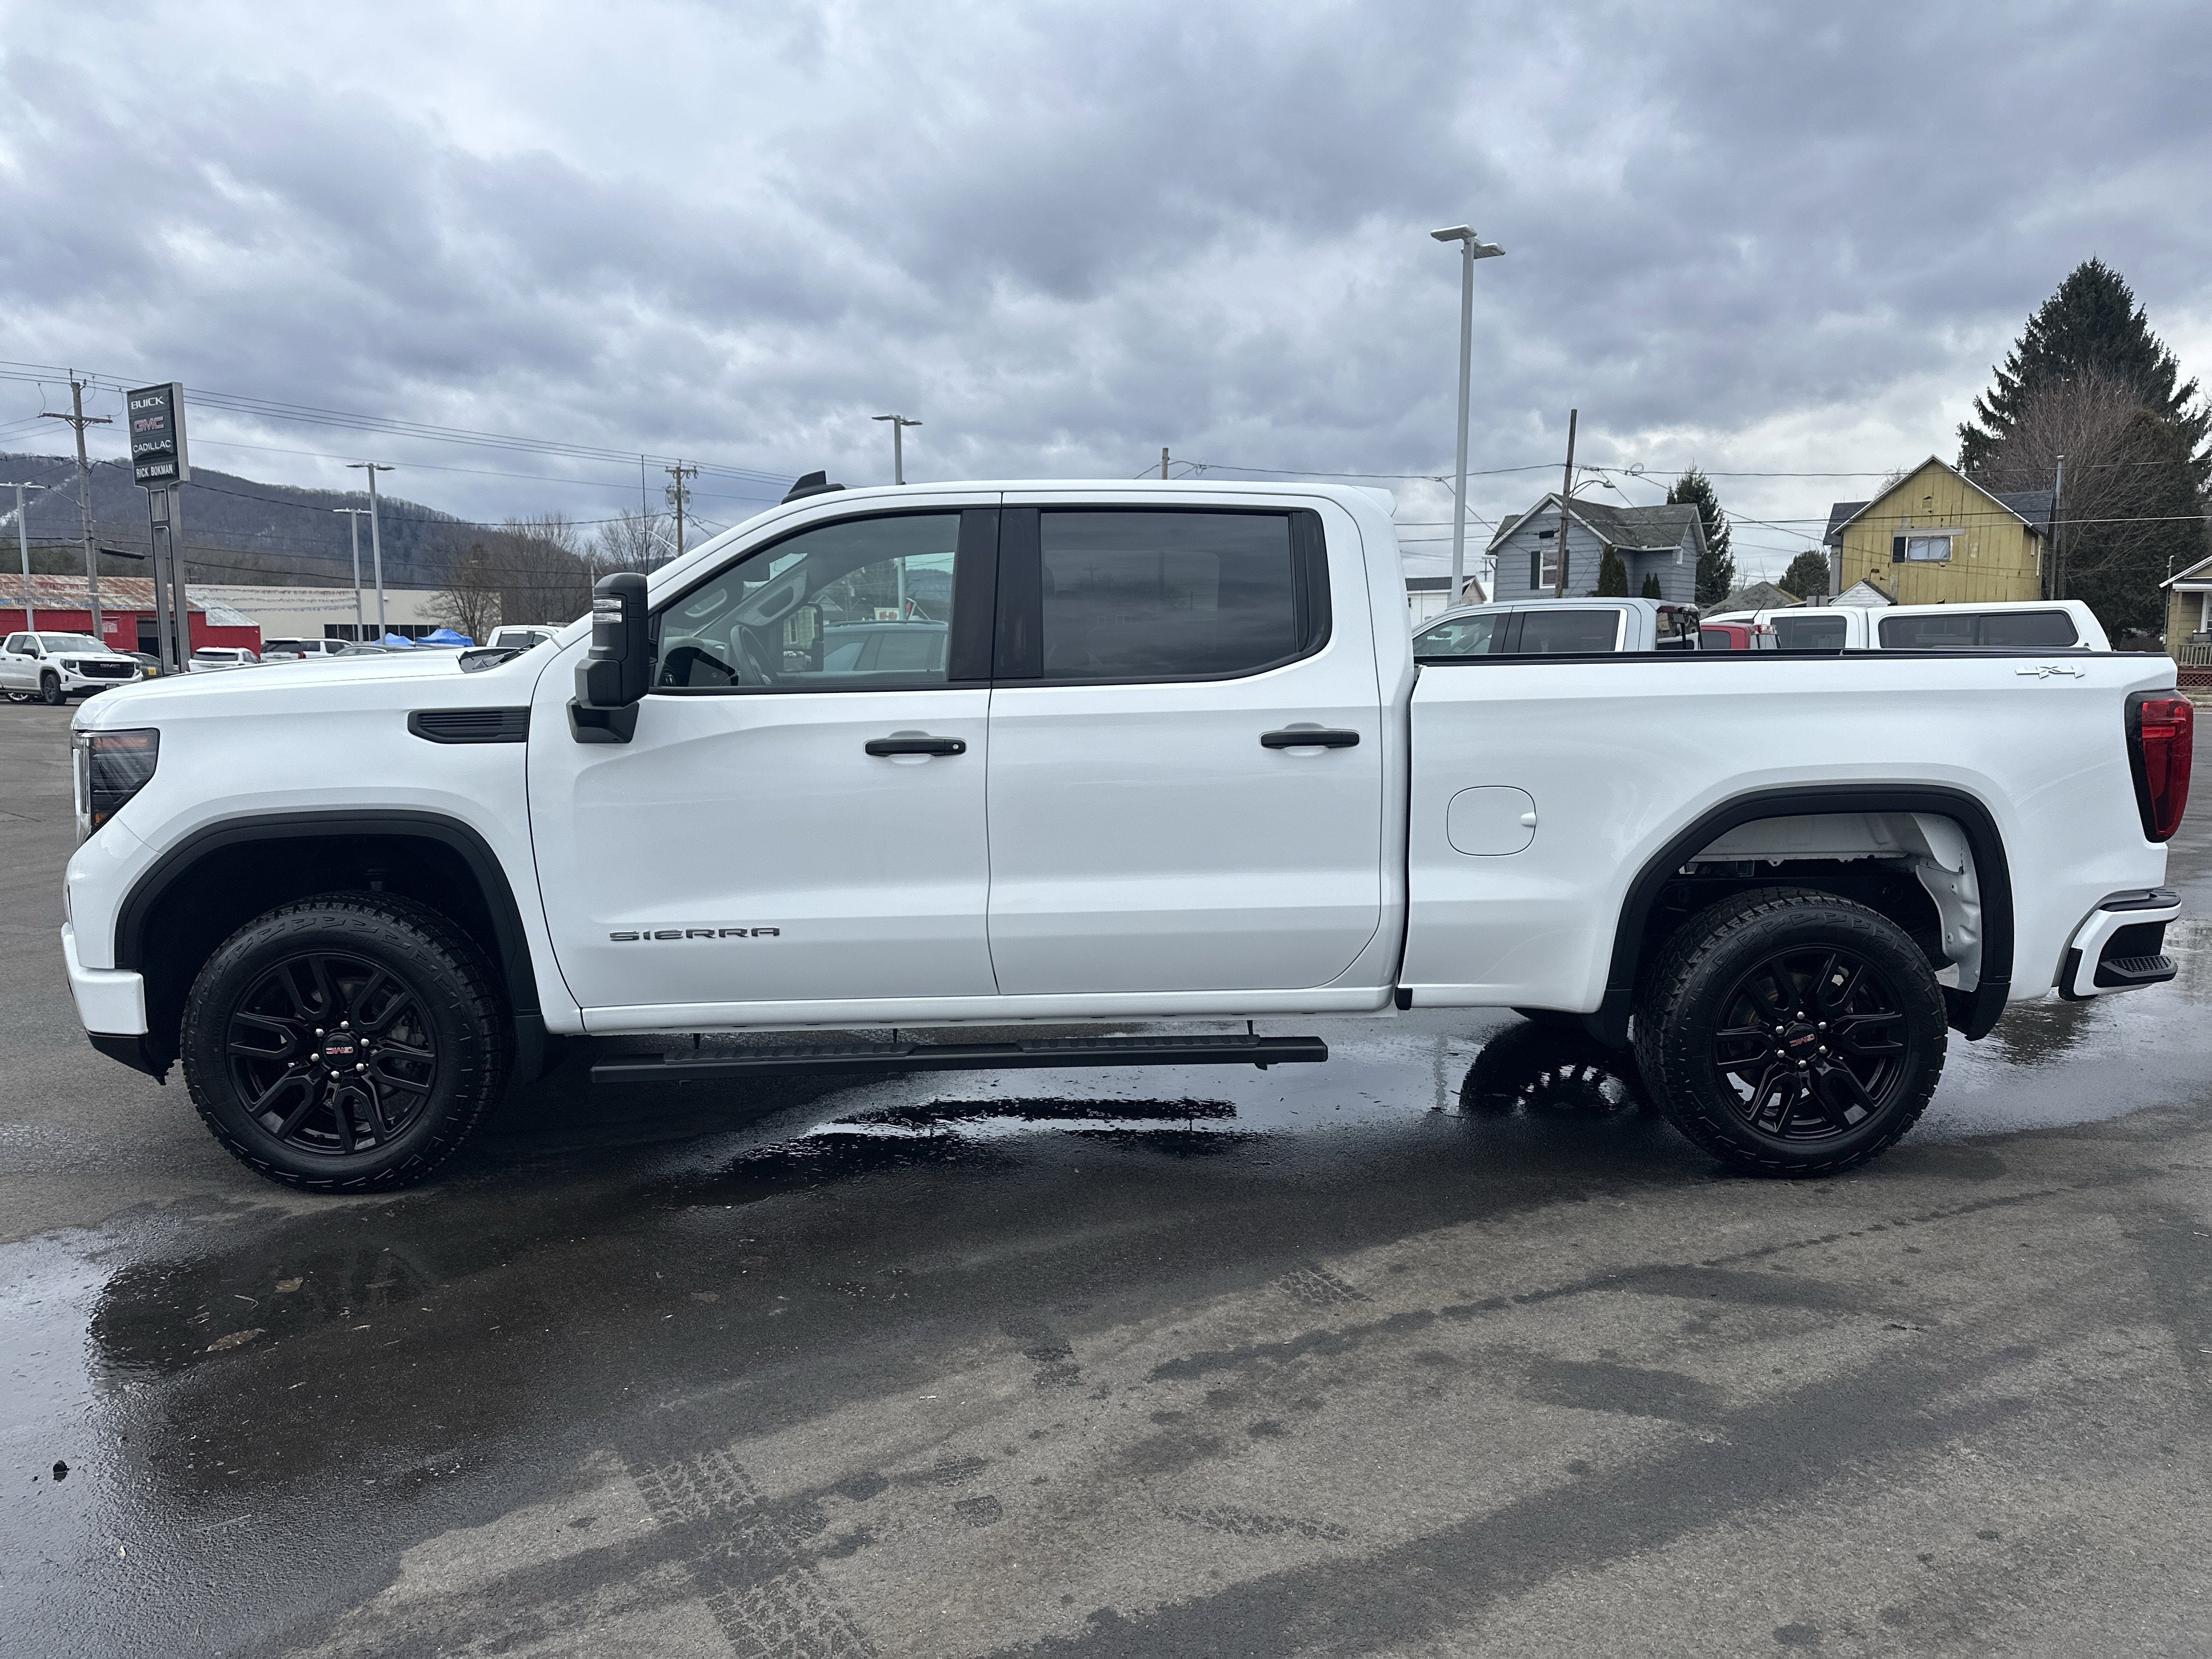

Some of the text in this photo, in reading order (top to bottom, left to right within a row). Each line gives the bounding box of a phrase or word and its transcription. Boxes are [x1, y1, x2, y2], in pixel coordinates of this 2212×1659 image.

[131, 396, 164, 410] BUICK
[134, 416, 165, 433] GMC
[133, 439, 171, 453] CADILLAC
[136, 464, 173, 478] RICK BOKMAN
[610, 926, 780, 940] SIERRA
[1790, 1034, 1815, 1047] GMC
